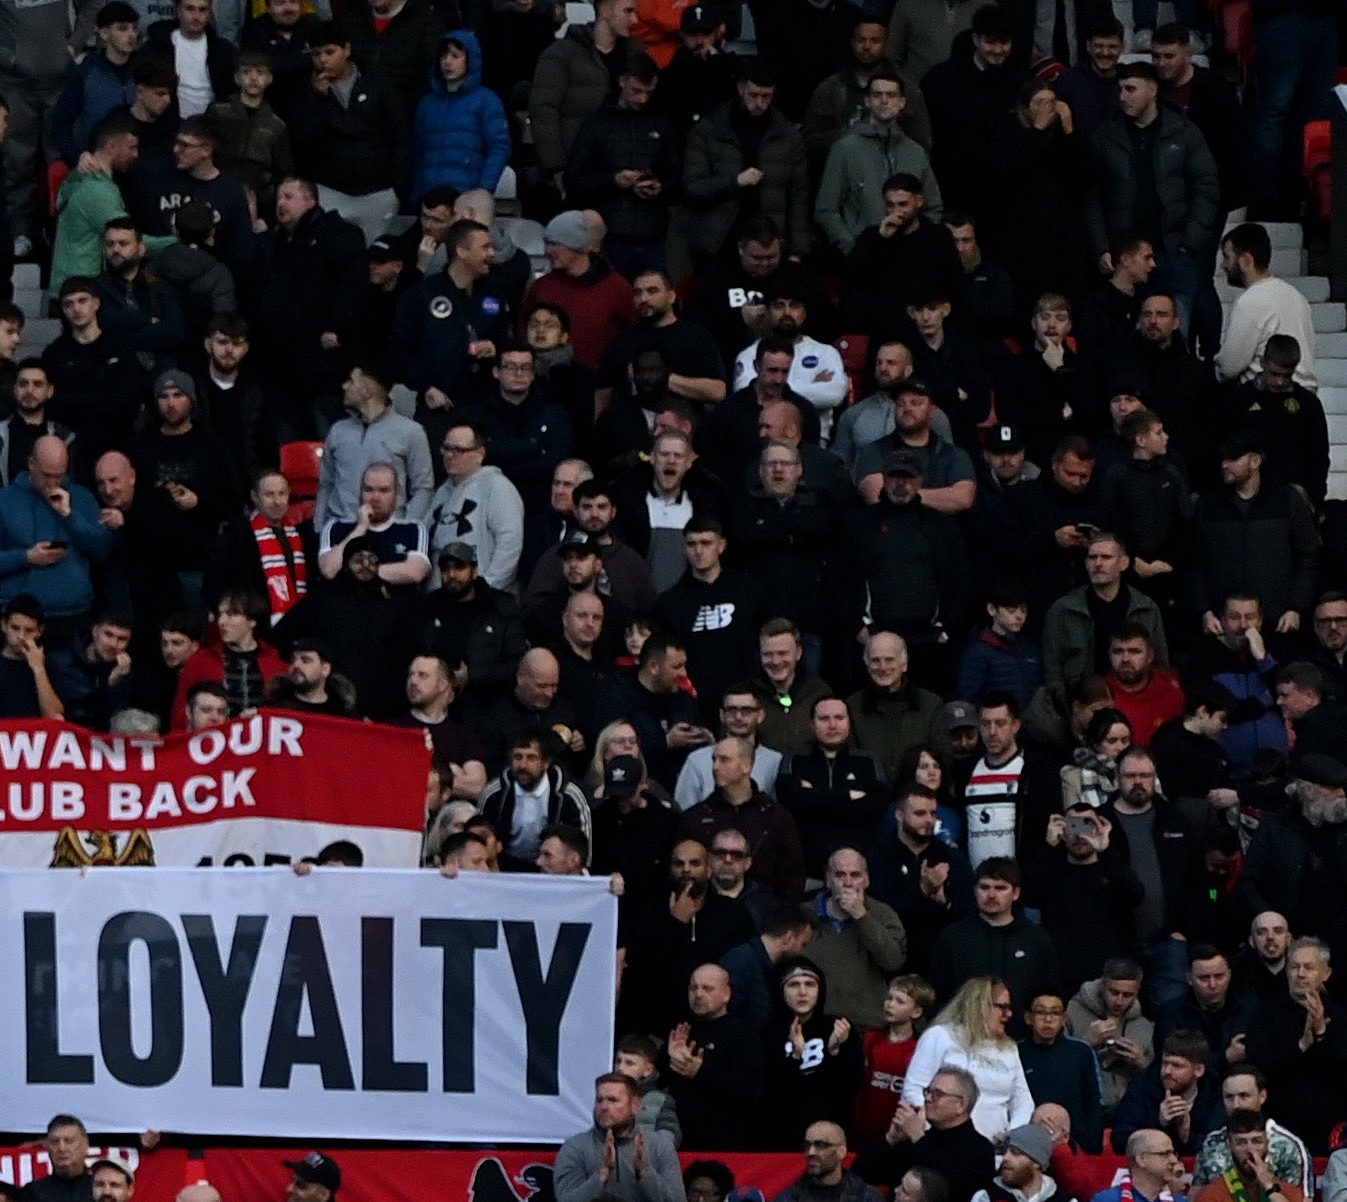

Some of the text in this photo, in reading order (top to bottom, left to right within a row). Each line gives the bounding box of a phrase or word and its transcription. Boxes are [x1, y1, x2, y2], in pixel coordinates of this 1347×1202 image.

[188, 716, 304, 765] OUR
[108, 767, 257, 821] BACK
[23, 911, 591, 1097] LOYALTY
